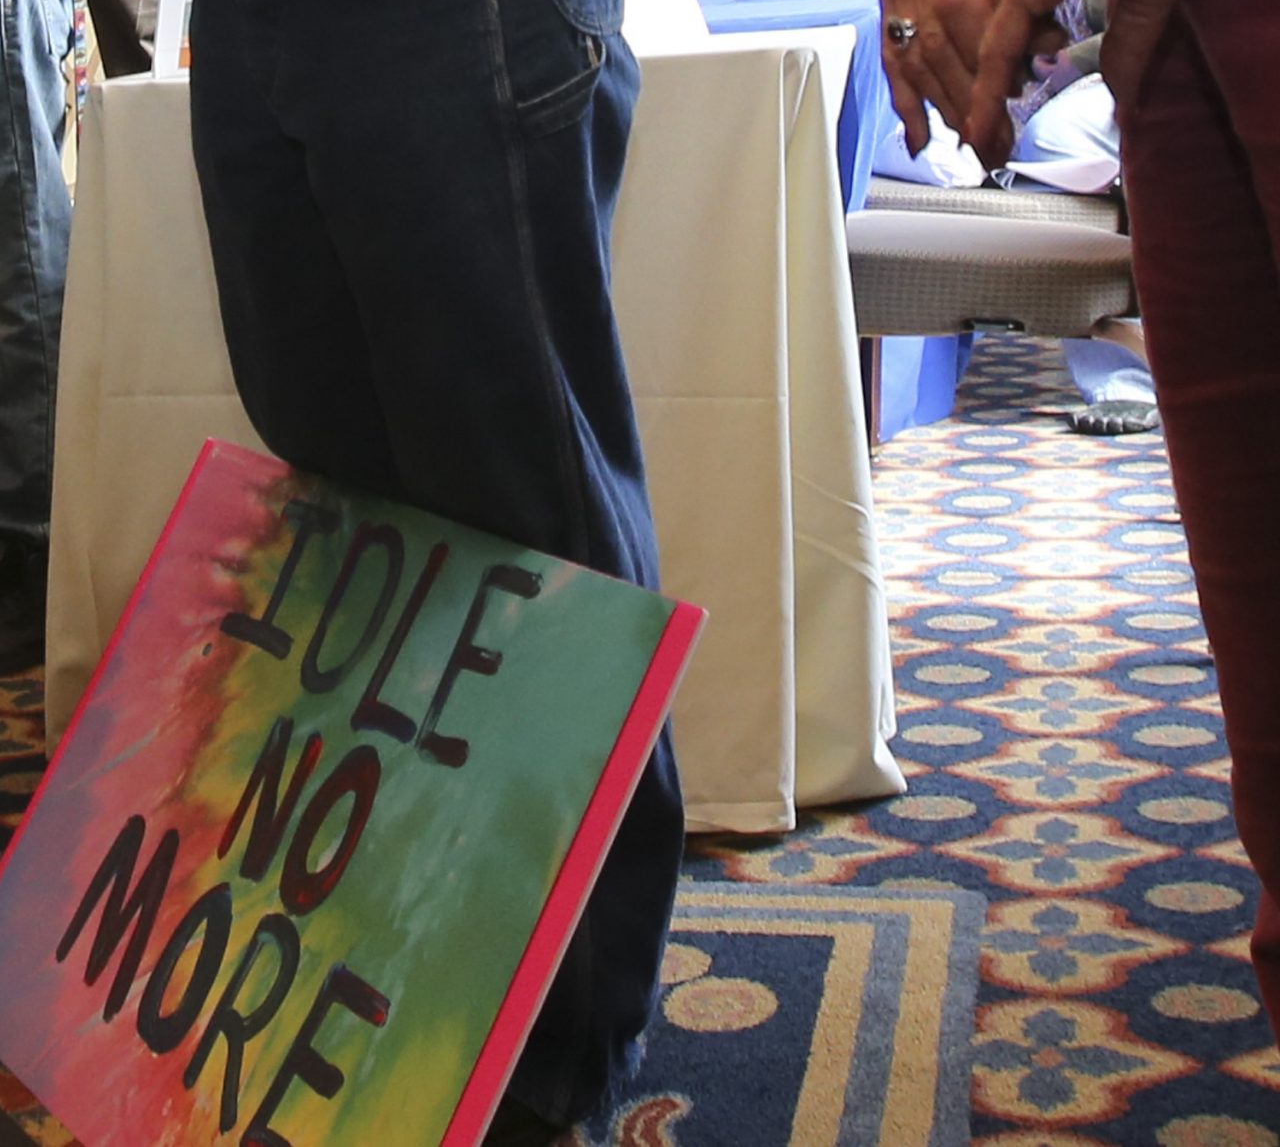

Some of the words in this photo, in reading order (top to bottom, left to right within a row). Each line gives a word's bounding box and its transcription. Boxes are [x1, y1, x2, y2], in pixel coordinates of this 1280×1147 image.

[221, 499, 542, 768] IDLE
[218, 716, 381, 915] NO
[56, 814, 391, 1147] MORE
